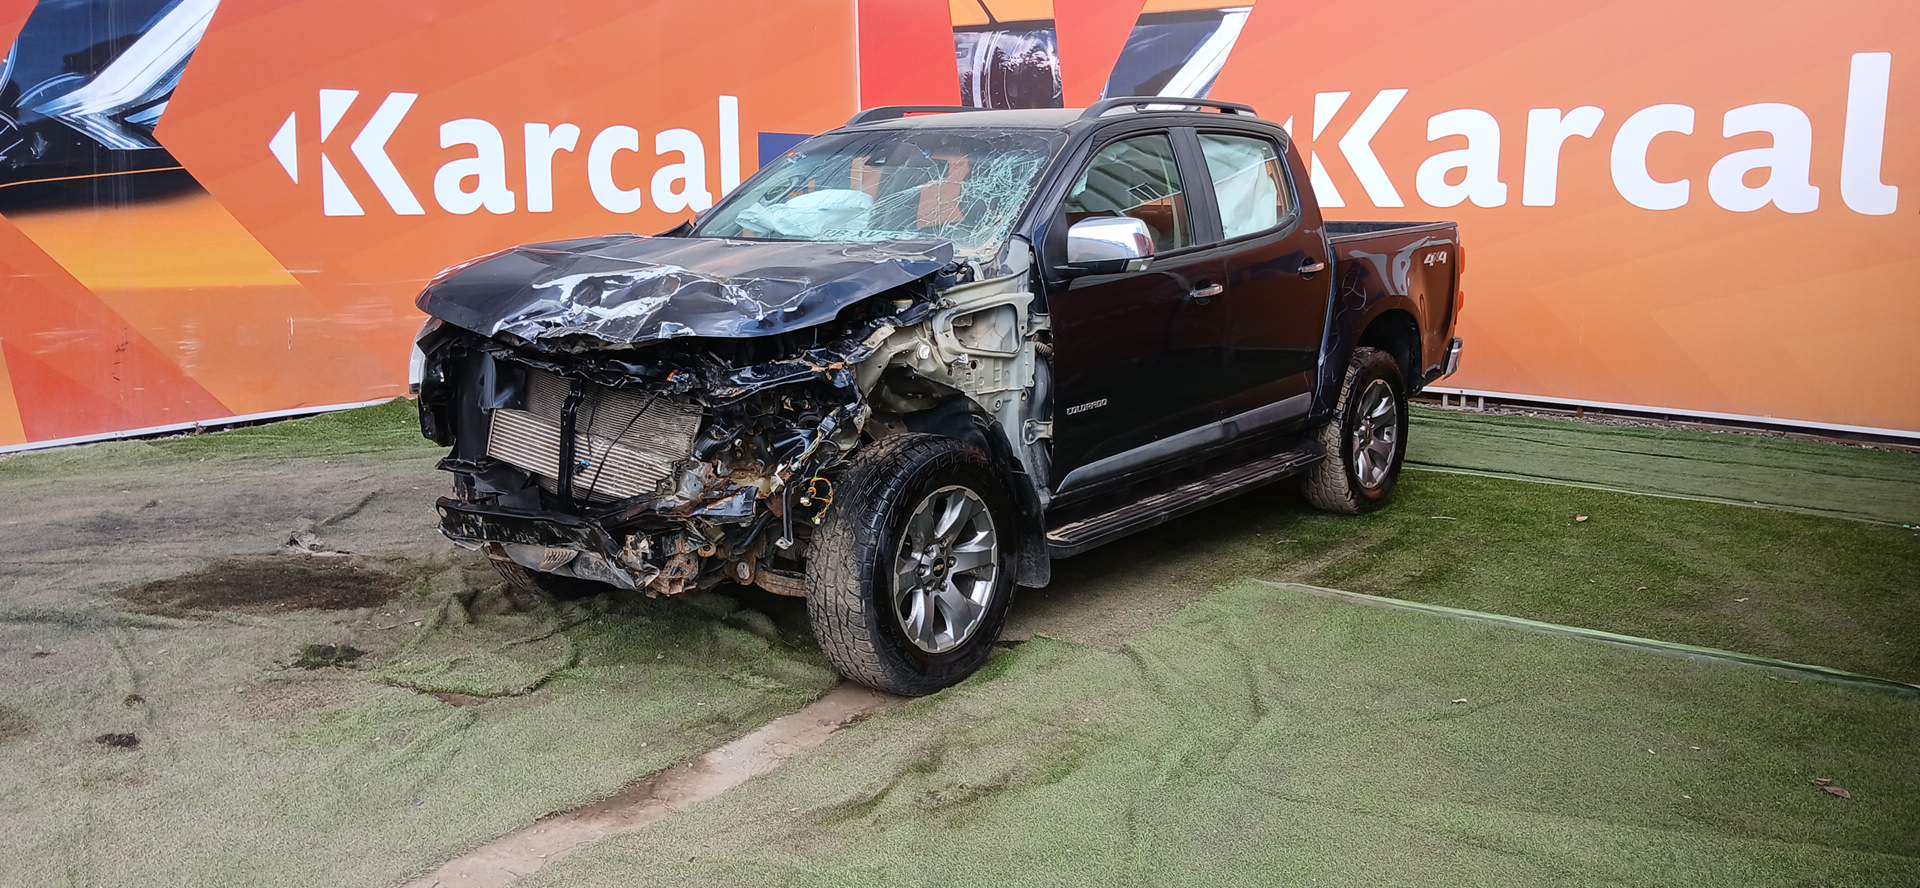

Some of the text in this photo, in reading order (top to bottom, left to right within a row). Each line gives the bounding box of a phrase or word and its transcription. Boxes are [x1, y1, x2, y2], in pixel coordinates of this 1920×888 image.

[318, 88, 742, 217] Karcal
[1310, 52, 1899, 216] Karcal
[1066, 398, 1108, 416] COLORADO
